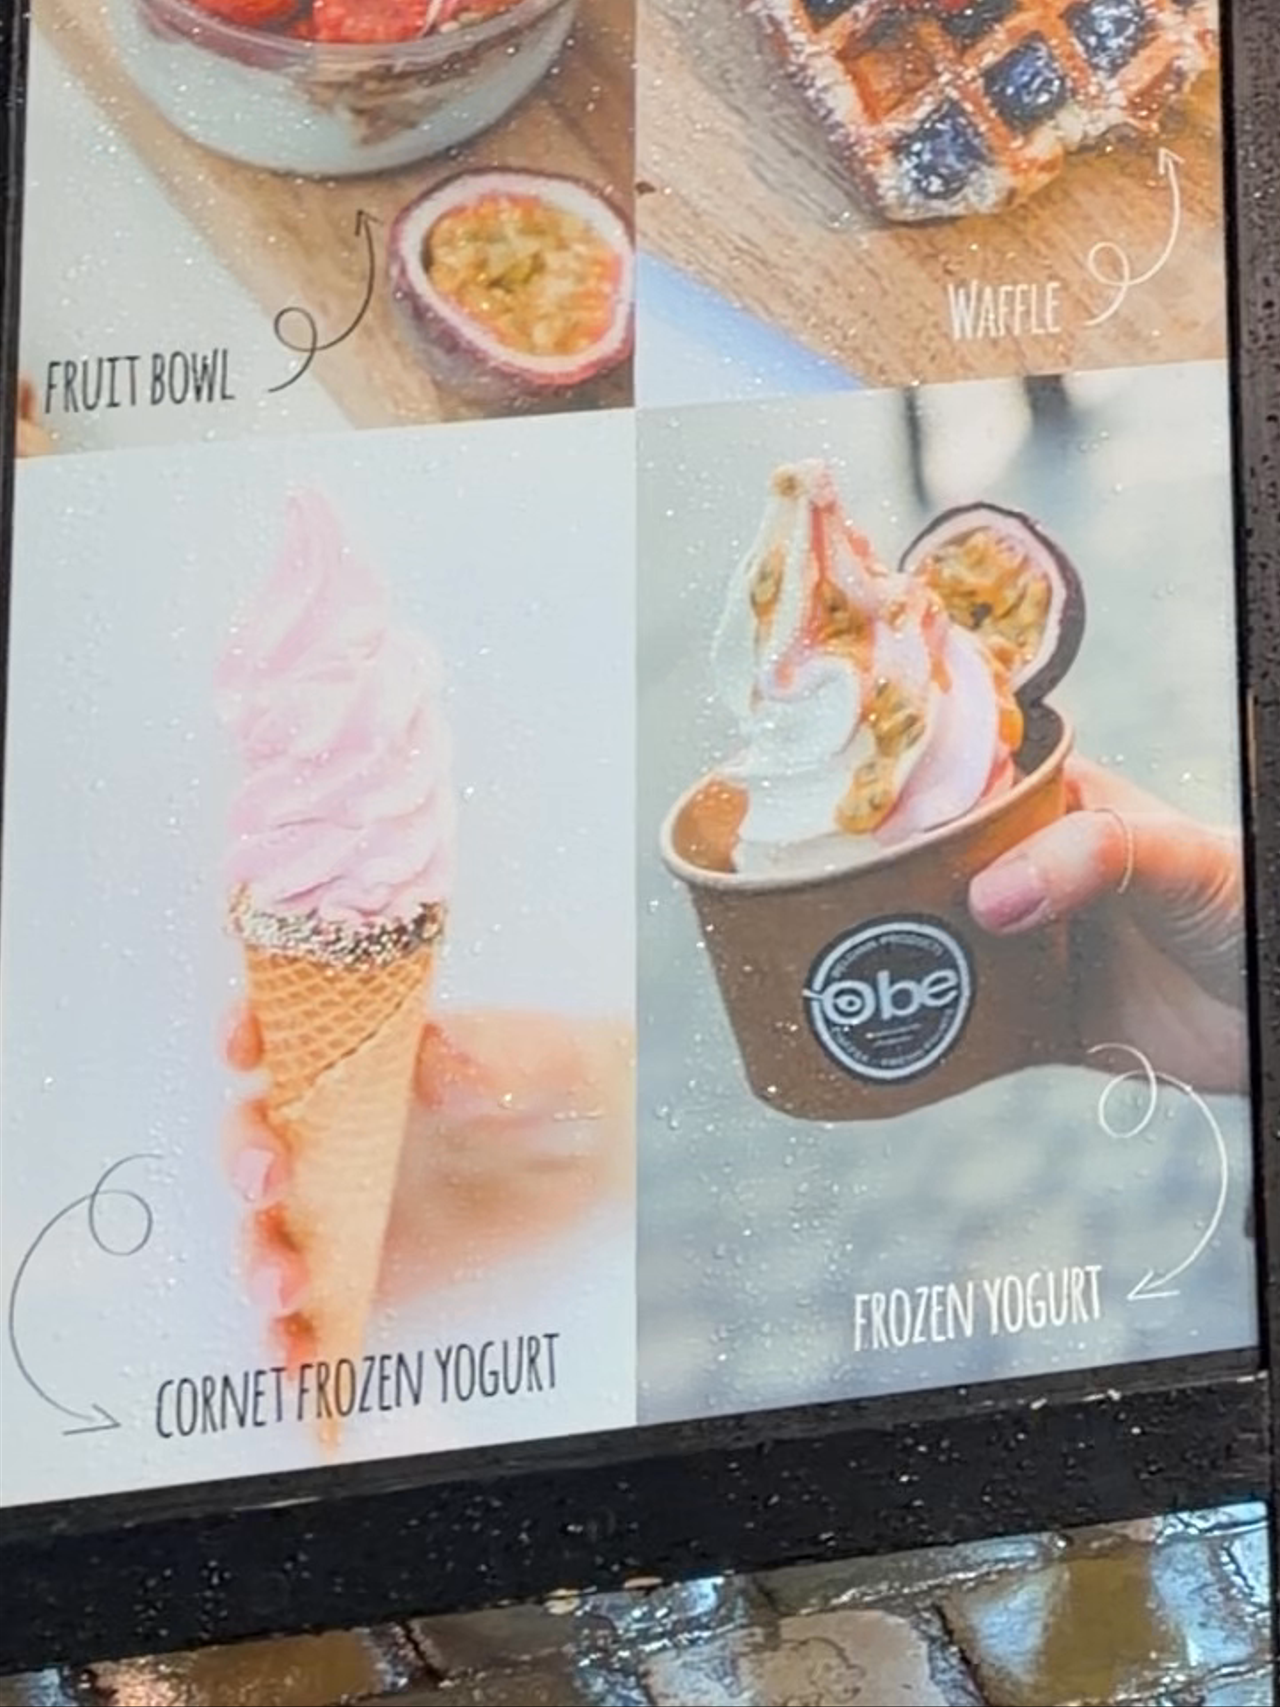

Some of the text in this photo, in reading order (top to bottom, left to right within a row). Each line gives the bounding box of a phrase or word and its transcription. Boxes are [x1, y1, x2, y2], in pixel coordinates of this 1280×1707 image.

[947, 278, 1062, 341] WAFFLE
[45, 348, 236, 414] FRUIT BOWL
[853, 1264, 1103, 1352] FROZEN YOGURT
[155, 1332, 561, 1438] CORNET FROZEN YOGURT
